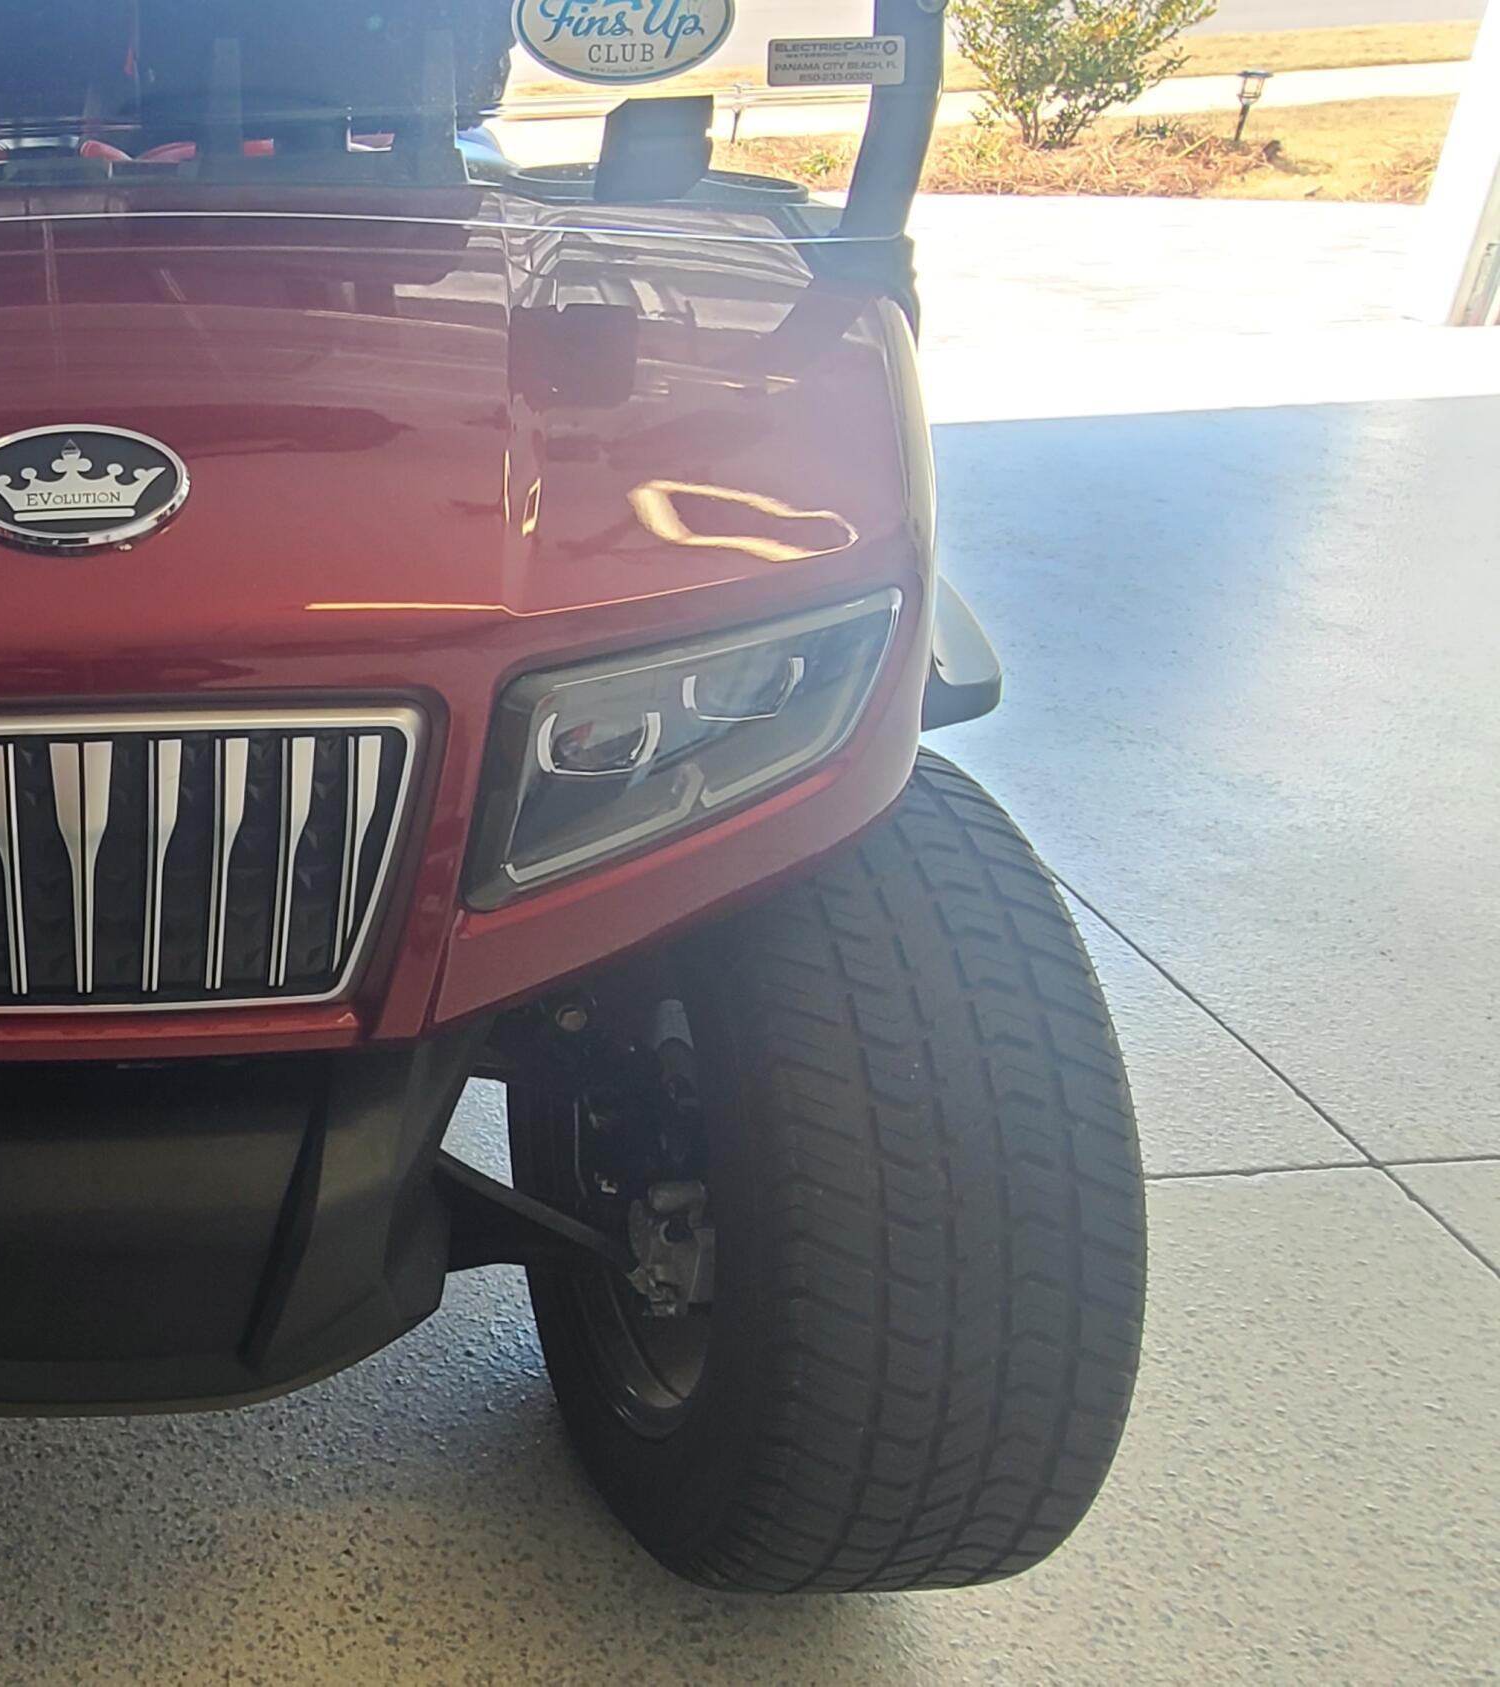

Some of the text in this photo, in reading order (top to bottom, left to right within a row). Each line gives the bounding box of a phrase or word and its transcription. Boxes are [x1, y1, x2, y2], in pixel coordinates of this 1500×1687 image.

[539, 0, 705, 59] Fins Up
[588, 43, 656, 63] CLUB
[774, 63, 821, 72] PANAMA
[822, 62, 846, 72] CITY
[886, 61, 898, 70] FL
